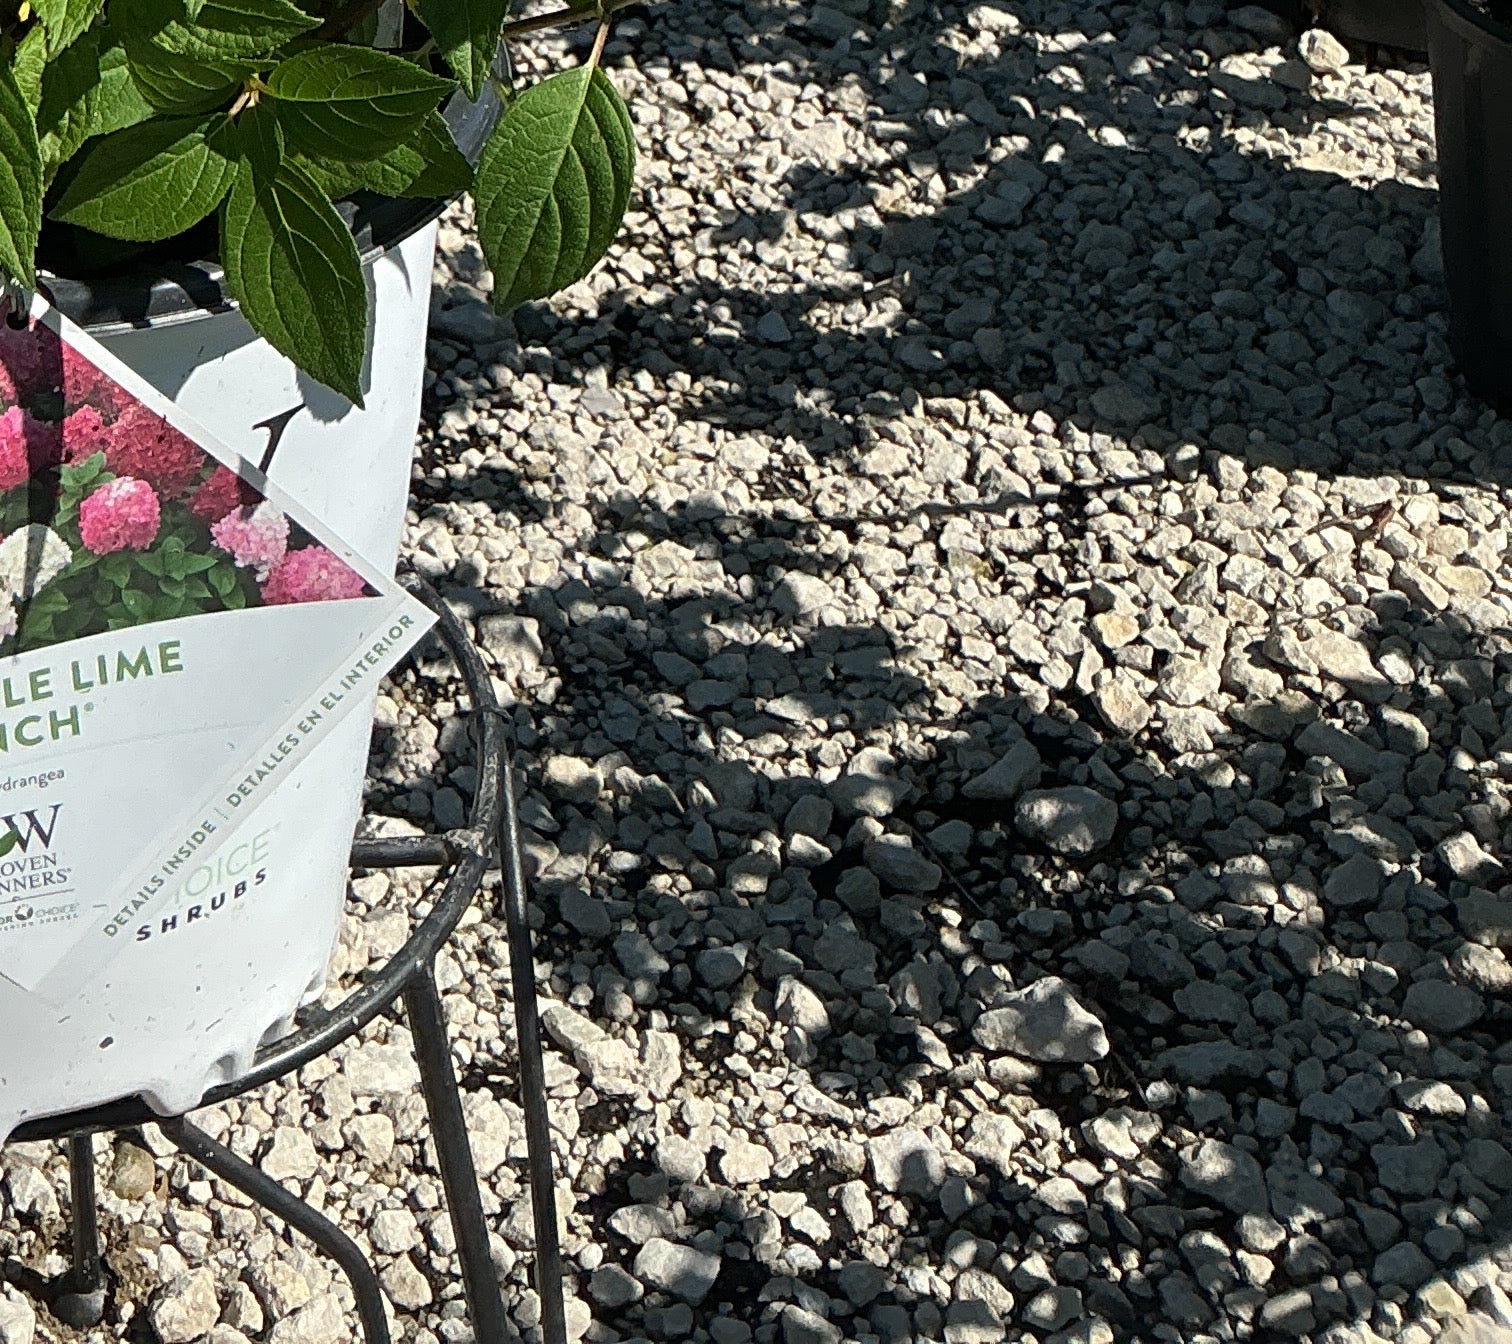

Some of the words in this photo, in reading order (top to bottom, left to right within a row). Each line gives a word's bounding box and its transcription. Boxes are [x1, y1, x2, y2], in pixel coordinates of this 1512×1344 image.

[71, 640, 184, 691] LIME
[103, 875, 165, 938] DETAILS
[162, 819, 217, 875] INSIDE
[226, 733, 300, 808] DETALLES
[297, 709, 323, 737] EN
[319, 691, 344, 711] EL
[340, 614, 415, 691] INTERIOR
[174, 828, 271, 904] OICE
[135, 867, 267, 942] SHRUBS
